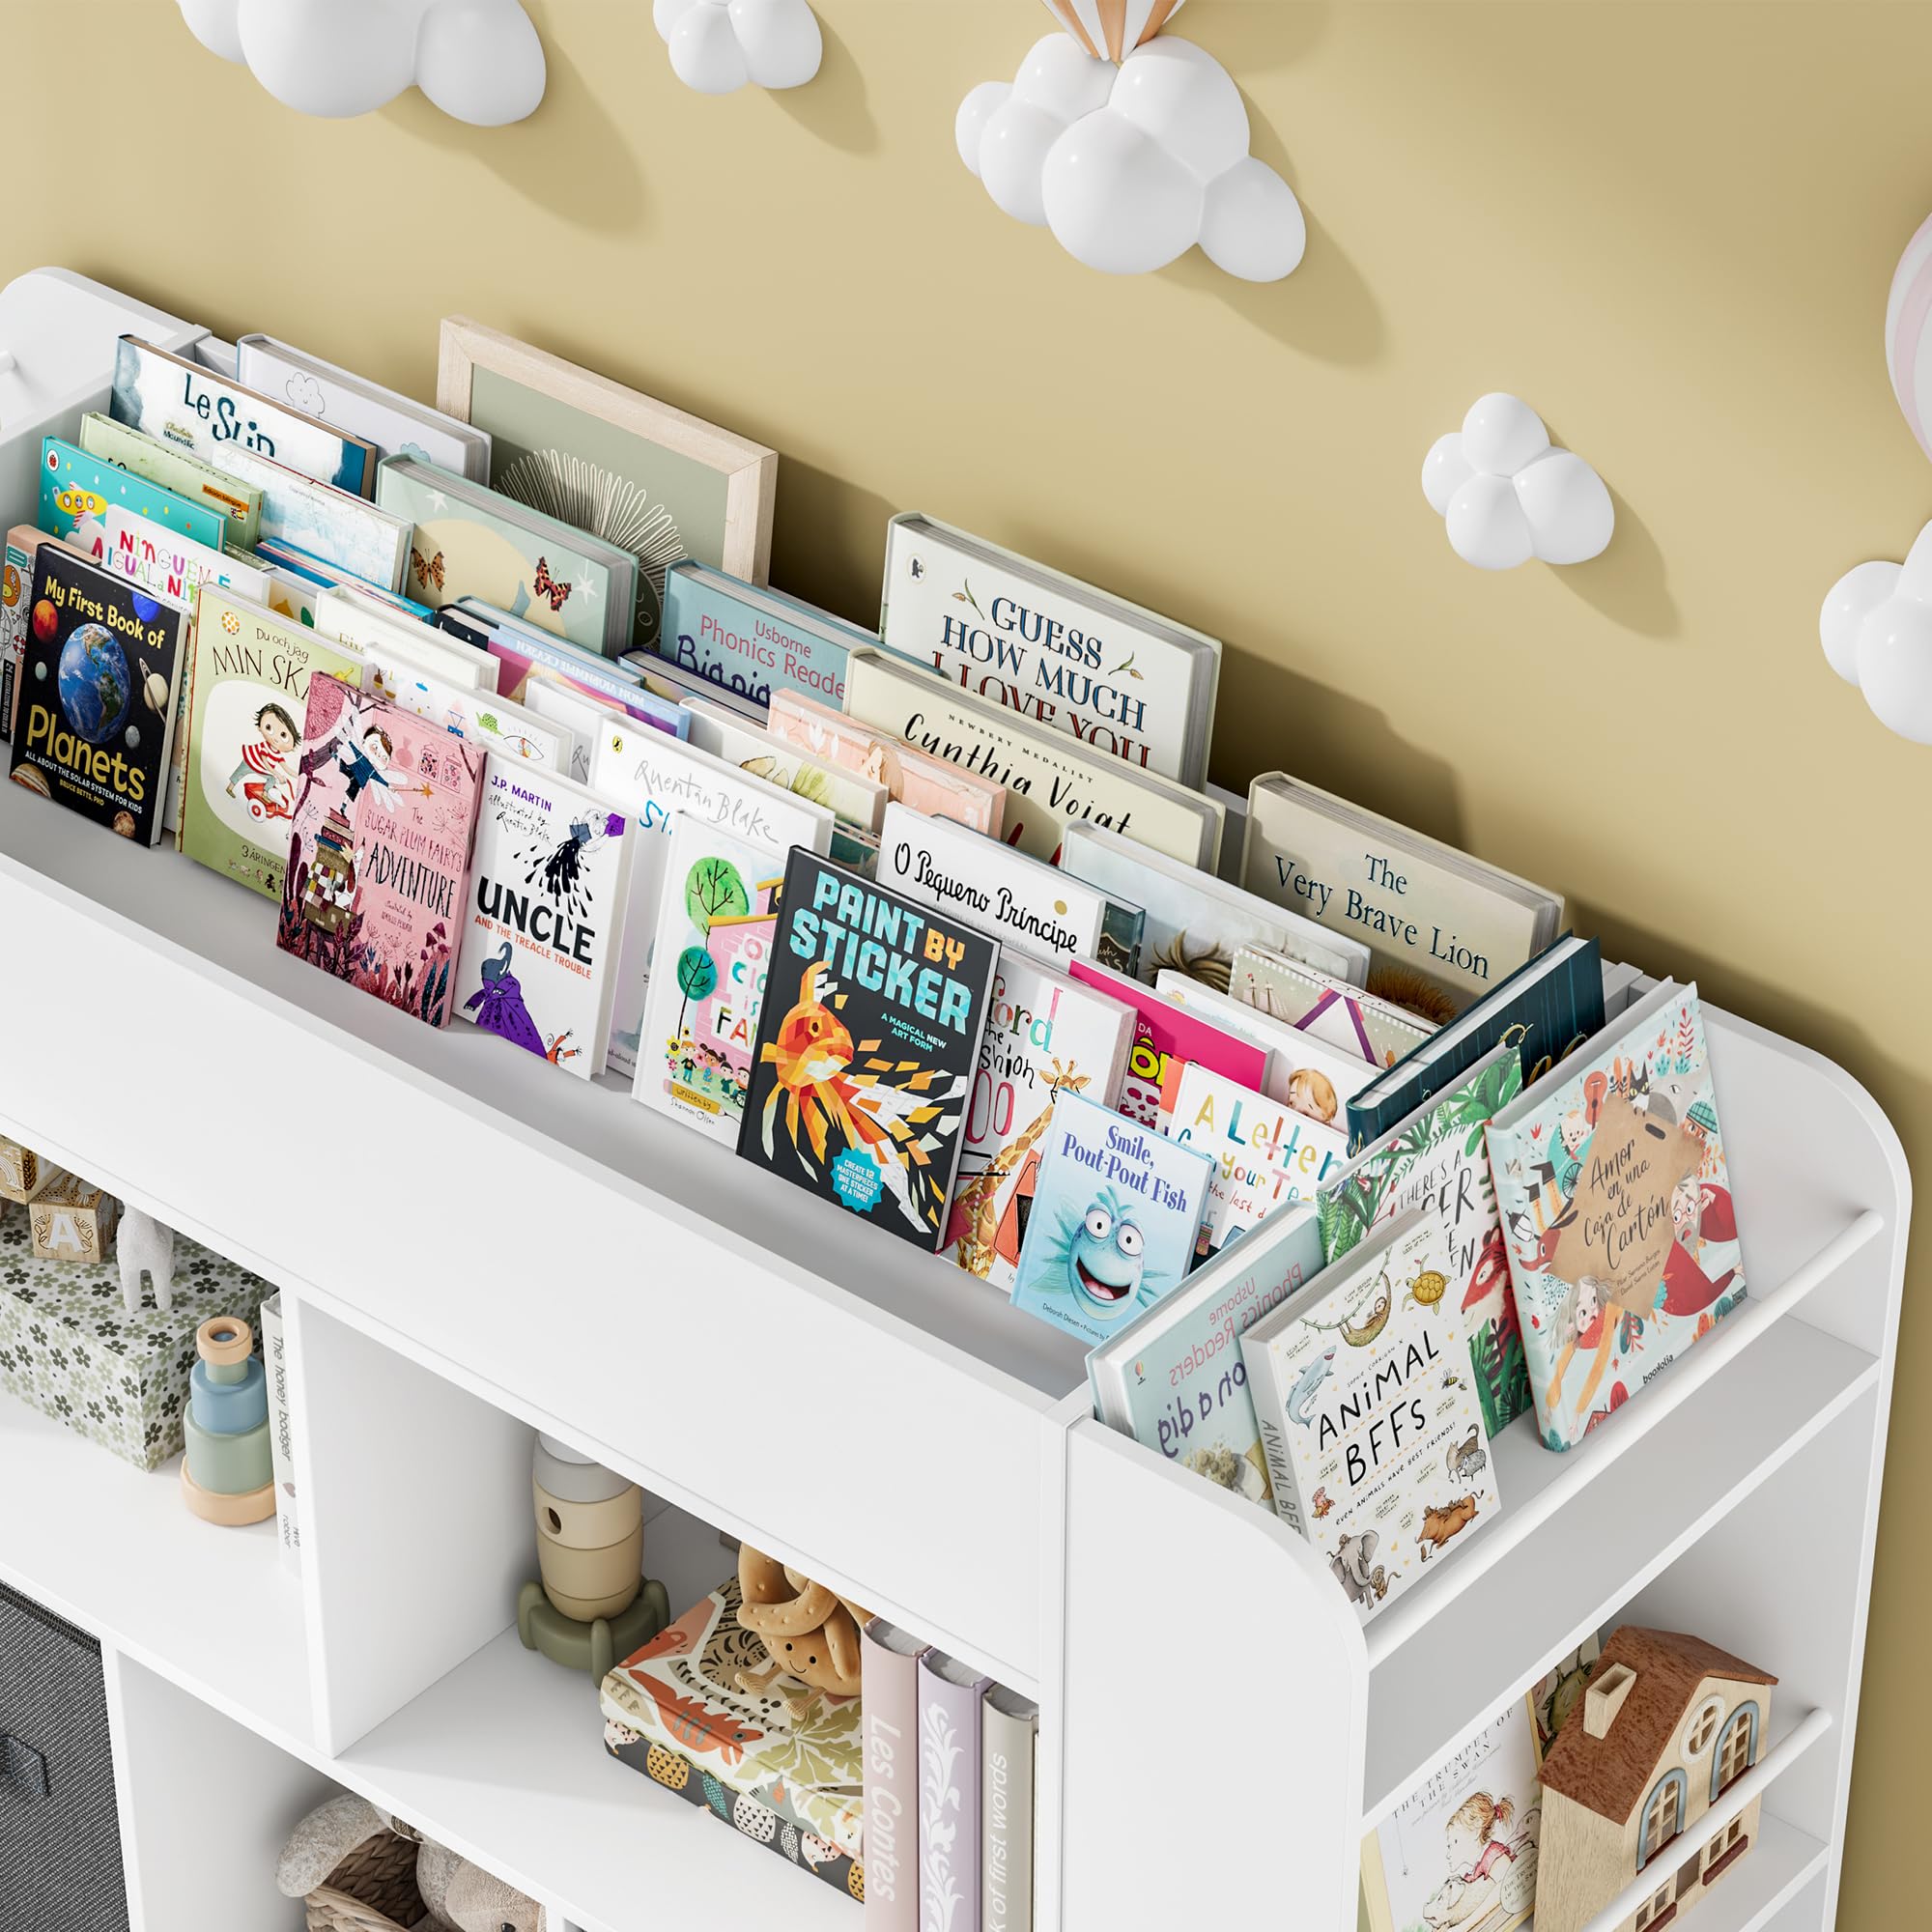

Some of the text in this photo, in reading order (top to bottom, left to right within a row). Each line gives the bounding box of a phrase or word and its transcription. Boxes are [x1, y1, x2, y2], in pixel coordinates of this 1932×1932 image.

[185, 373, 211, 419] Le
[44, 575, 165, 649] My First Book of
[754, 619, 811, 658] Usborne
[991, 597, 1102, 669] GUESS
[5, 662, 14, 673] 24
[213, 645, 262, 677] MIN
[256, 628, 309, 664] Du och jag
[700, 614, 776, 668] Phonics
[783, 652, 845, 701] Reade
[940, 614, 1148, 733] HOW MUCH
[27, 704, 146, 801] Planets
[903, 712, 1033, 796] Cynthia
[948, 713, 1094, 784] NEWBERY MEDALIST
[25, 751, 143, 814] ALL ABOUT THE SOLAR SYSTEM FOR KIDS
[59, 779, 77, 792] BRUCE
[491, 776, 553, 811] J.P. MARTIN
[634, 760, 712, 809] Quentin
[707, 792, 779, 843] Blake
[364, 809, 463, 872] SUGAR PLUM FAIRY'S
[412, 807, 423, 825] The
[242, 845, 249, 858] 3
[365, 842, 456, 919] ADVENTURE
[1365, 853, 1407, 894] The
[477, 875, 595, 965] UNCLE
[812, 870, 925, 954] PAINT
[923, 927, 965, 971] BY
[894, 842, 911, 875] O
[914, 850, 990, 913] Pequeno
[995, 887, 1078, 953] Príncipe
[1275, 855, 1490, 980] Very Brave Lion
[475, 915, 592, 980] AND THE TREACLE TROUBLE
[789, 908, 972, 1036] STICKER
[889, 1016, 925, 1039] MAGICAL
[926, 1034, 947, 1049] NEW
[892, 1027, 932, 1053] ART FORM
[1106, 1125, 1154, 1169] Smile,
[1194, 1094, 1345, 1181] A Letter
[1590, 1139, 1635, 1195] Amor
[837, 1164, 878, 1190] MASTERPIECES
[844, 1160, 874, 1179] CREATE 12
[851, 1180, 874, 1197] STICKER
[1061, 1131, 1149, 1194] Pout-Pout
[1151, 1176, 1187, 1213] Fish
[1221, 1151, 1266, 1190] your
[1400, 1150, 1462, 1209] THERE'S A
[1607, 1159, 1651, 1200] en una
[48, 1212, 85, 1253] A
[1230, 1190, 1253, 1213] last
[1584, 1189, 1632, 1247] Caja de
[1607, 1194, 1667, 1270] Cartón
[1042, 1303, 1063, 1320] Deborah
[272, 1336, 291, 1461] The honey badger
[1346, 1399, 1426, 1487] BFFS
[1392, 1708, 1515, 1819] THE TRUMPET OF
[1420, 1743, 1491, 1808] THE SWAN
[870, 1714, 902, 1902] Les Contes
[988, 1753, 1009, 1915] of first words
